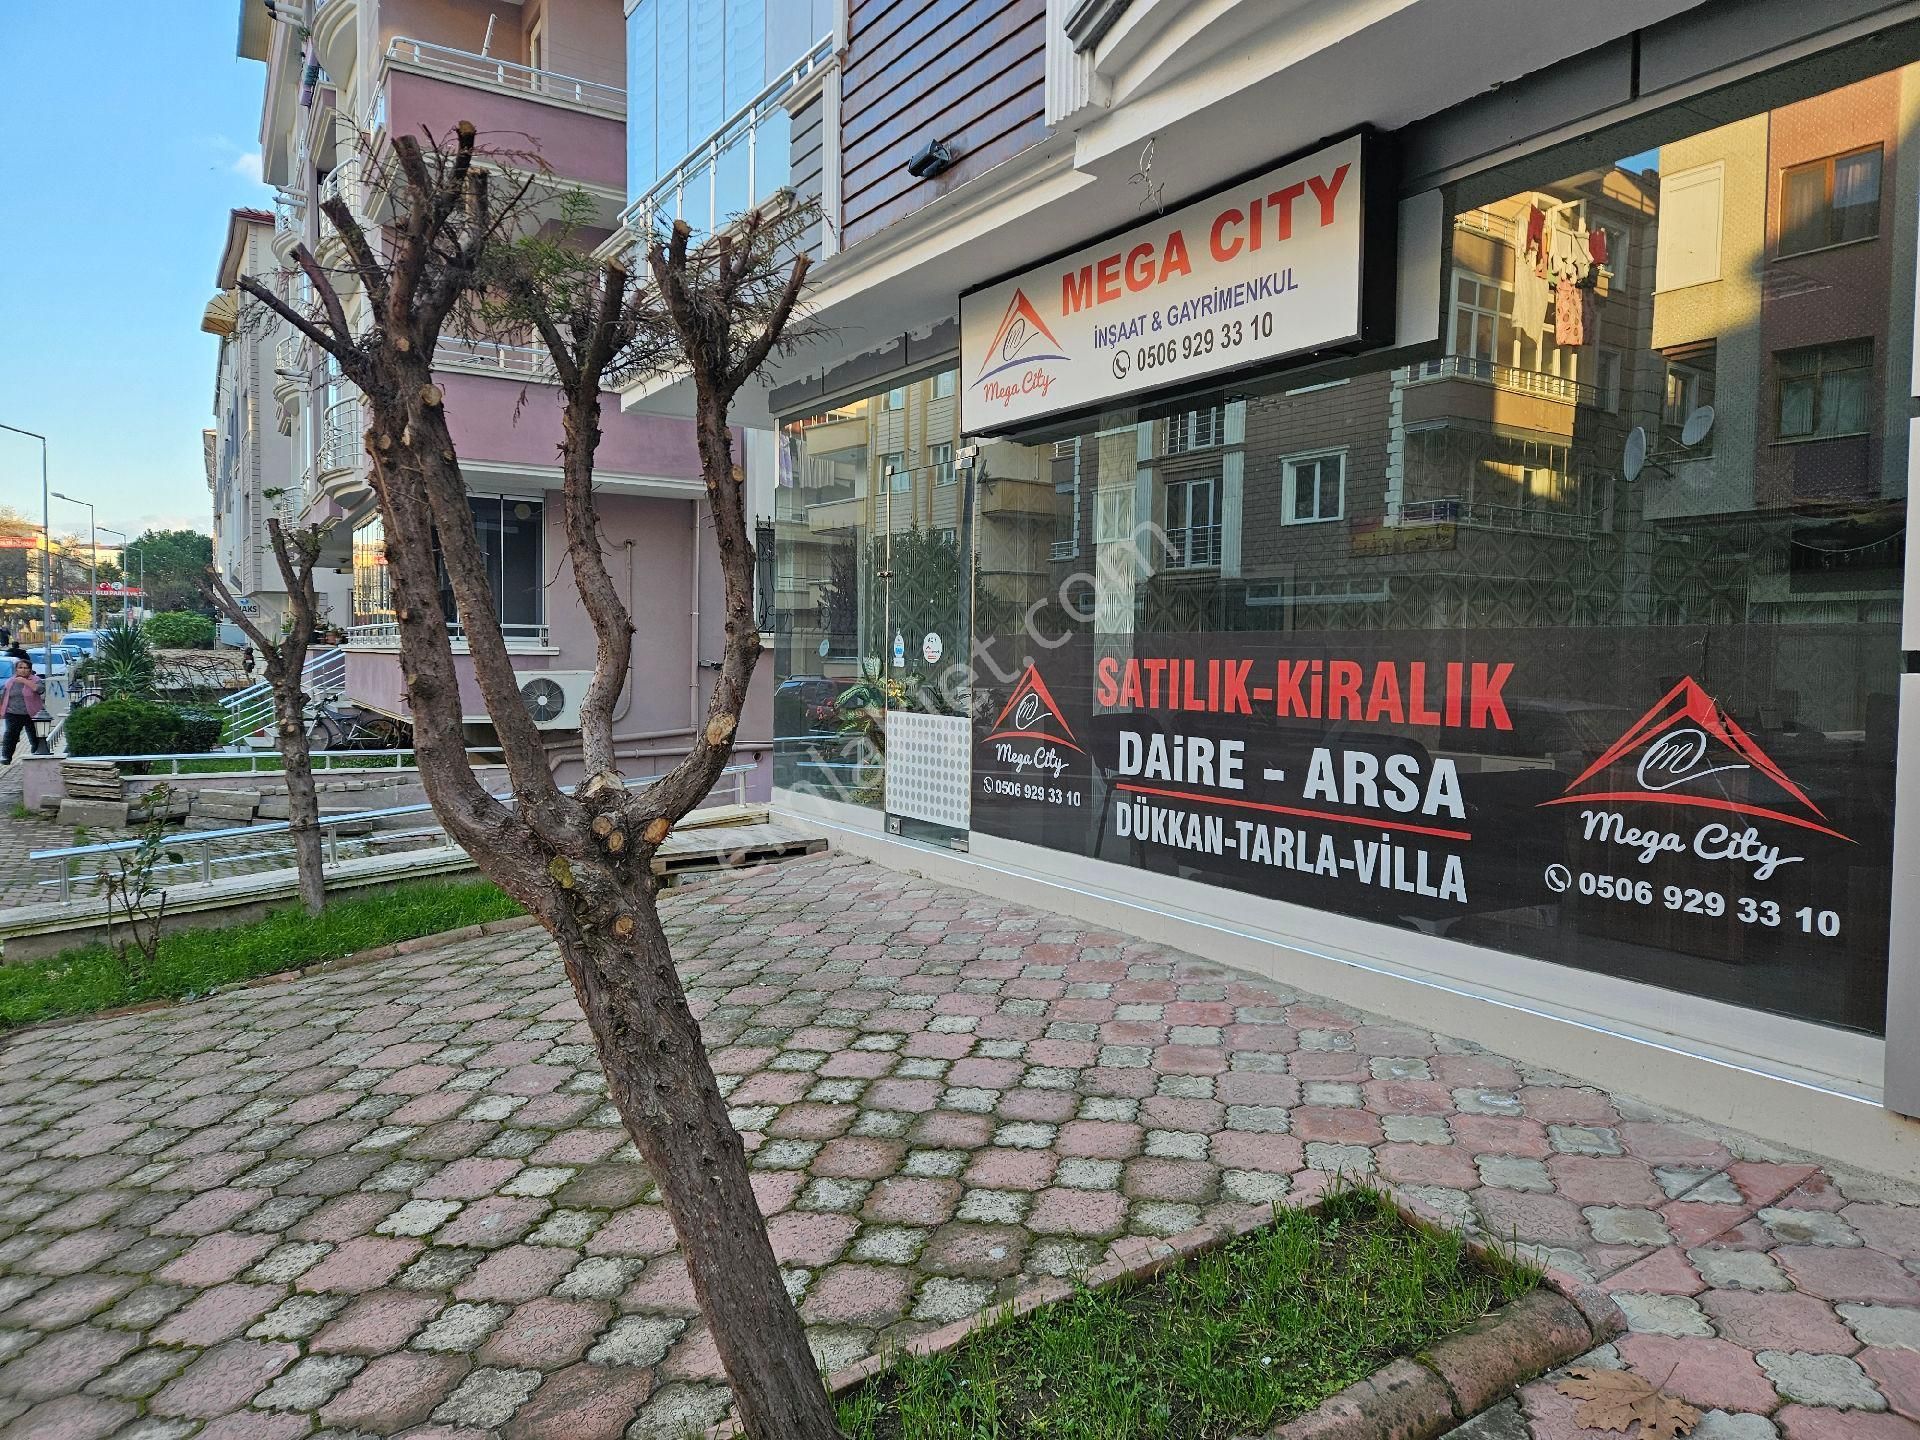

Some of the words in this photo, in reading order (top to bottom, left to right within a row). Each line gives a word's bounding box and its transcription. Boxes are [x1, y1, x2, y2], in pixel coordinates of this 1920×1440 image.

[1062, 230, 1192, 316] MEGA
[1210, 163, 1352, 262] CITY
[1094, 314, 1147, 349] İNŞAAT
[1151, 311, 1162, 332] &
[1167, 268, 1298, 326] GAYRİMENKUL
[1137, 339, 1177, 371] 0506
[1182, 328, 1214, 360] 929
[1220, 320, 1243, 349] 33
[1251, 311, 1273, 340] 10
[984, 381, 1020, 407] Mega
[1022, 368, 1056, 397] City
[995, 743, 1033, 773] Mega
[1033, 746, 1070, 778] City
[1302, 747, 1467, 820] ARSA
[995, 780, 1021, 797] 0506
[1024, 784, 1045, 801] 929
[1048, 787, 1063, 804] 33
[1066, 790, 1081, 807] 10
[1581, 810, 1686, 864] Mega
[1693, 823, 1804, 881] City
[1579, 872, 1653, 905] 0506
[1663, 885, 1726, 917] 929
[1737, 897, 1781, 928] 33
[1795, 907, 1841, 937] 10
